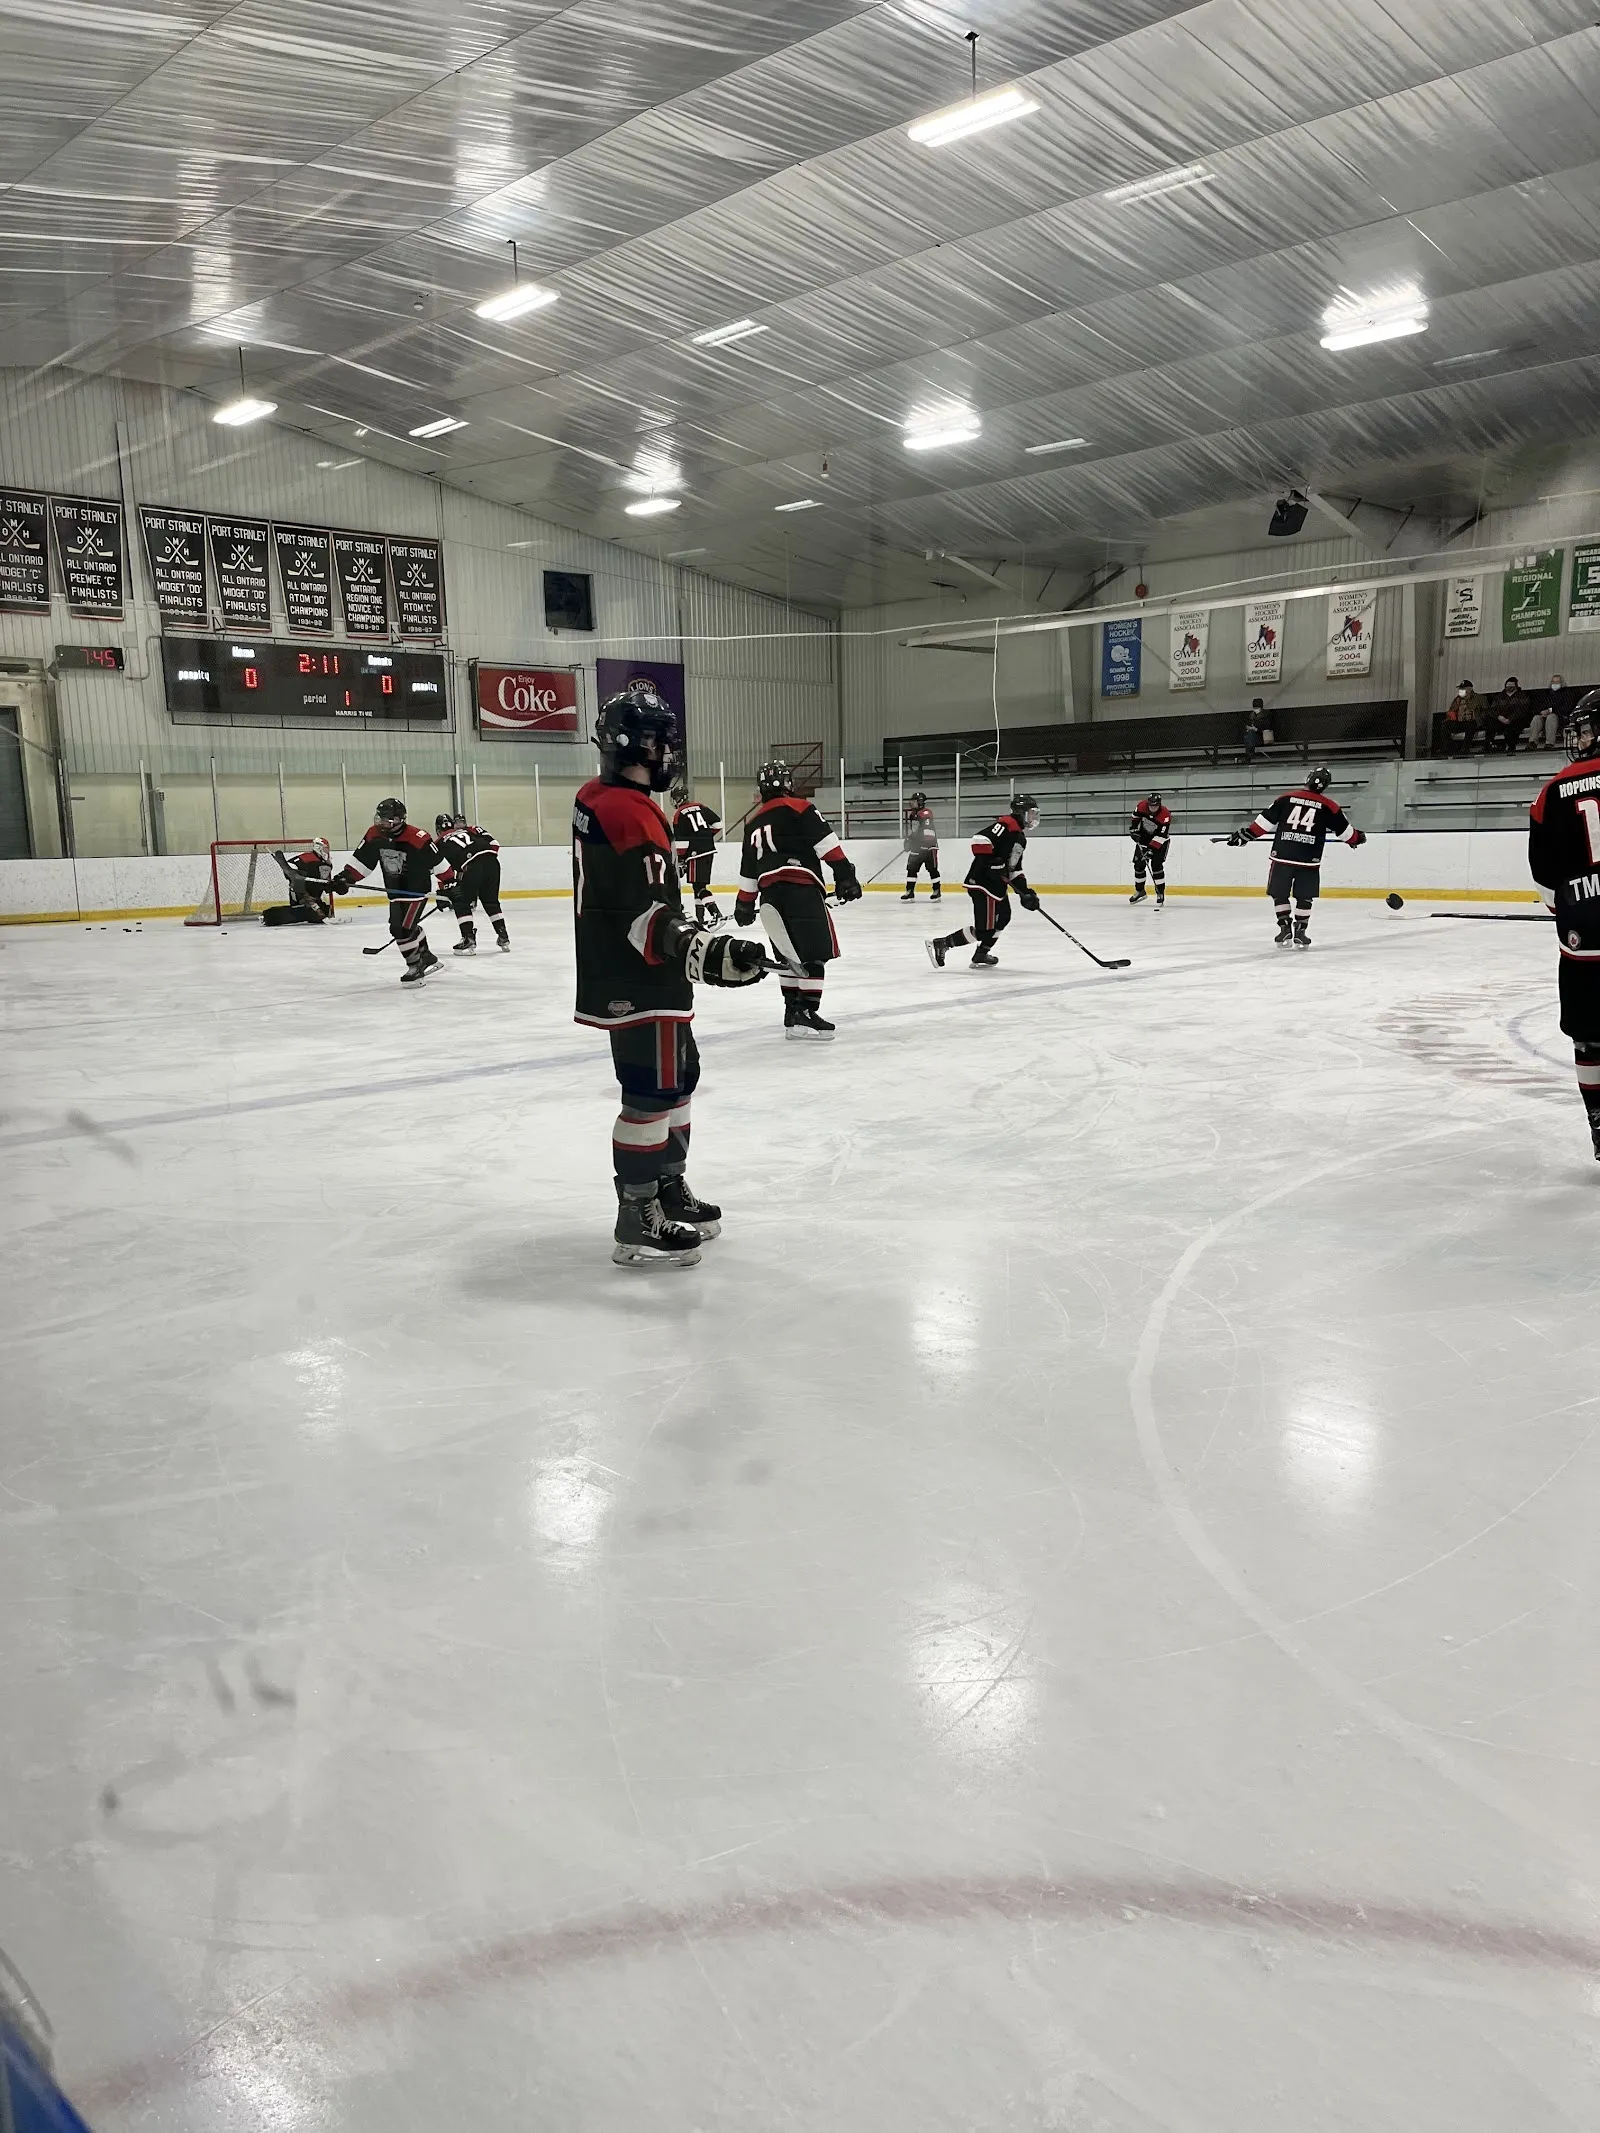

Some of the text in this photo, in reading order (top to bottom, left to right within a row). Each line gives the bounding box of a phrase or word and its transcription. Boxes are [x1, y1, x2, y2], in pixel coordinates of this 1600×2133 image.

[6, 500, 44, 516] STANLEY
[55, 506, 117, 524] PORT STANLEY
[145, 517, 202, 534] PORT STANLEY
[212, 525, 266, 542] PORT STANLEY
[277, 533, 328, 548] PORT STANLEY
[335, 539, 384, 555] PORT STANLEY
[391, 546, 437, 560] PORT STANLEY
[9, 554, 44, 566] ONTARIO
[67, 559, 116, 573] ALL ONTARIO
[70, 573, 101, 585] PEEWEE
[156, 568, 202, 581] ALL ONTARIO
[1512, 572, 1553, 583] REGIONAL
[0, 580, 44, 594] INALISTS
[157, 581, 185, 592] MIDGET
[222, 575, 266, 587] ALL ONTARIO
[287, 581, 328, 593] ALL ONTARIO
[71, 587, 118, 600] FINALISTS
[223, 587, 250, 598] MIDGET
[351, 584, 376, 594] ONTARIO
[160, 595, 203, 607] FINALISTS
[289, 594, 311, 603] ATOM
[346, 594, 383, 604] REGION ONE
[400, 591, 436, 601] ALL ONTARIO
[1338, 592, 1368, 600] WOMEN'S
[226, 600, 266, 612] FINALISTS
[290, 606, 328, 617] CHAMPIONS
[348, 604, 372, 614] NOVICE
[403, 603, 422, 612] ATOM
[348, 613, 385, 624] CHAMPIONS
[402, 615, 437, 624] FINALISTS
[1511, 608, 1551, 621] CHAMPIONS
[1109, 628, 1135, 637] HOCKEY
[1338, 653, 1361, 661] 2004
[298, 653, 339, 674] 2:11
[1181, 667, 1200, 675] 2000
[245, 668, 258, 688] 0
[382, 675, 392, 693] 0
[518, 675, 535, 684] Enjoy
[1113, 674, 1129, 682] 1998
[498, 676, 556, 712] Coke
[631, 682, 653, 694] LIONS
[303, 690, 351, 706] period 1
[1559, 775, 1600, 798] HOPKINS
[687, 812, 708, 832] 14
[1286, 806, 1316, 832] 44
[992, 823, 1005, 837] 91
[449, 833, 475, 848] 12
[643, 853, 666, 884] 17
